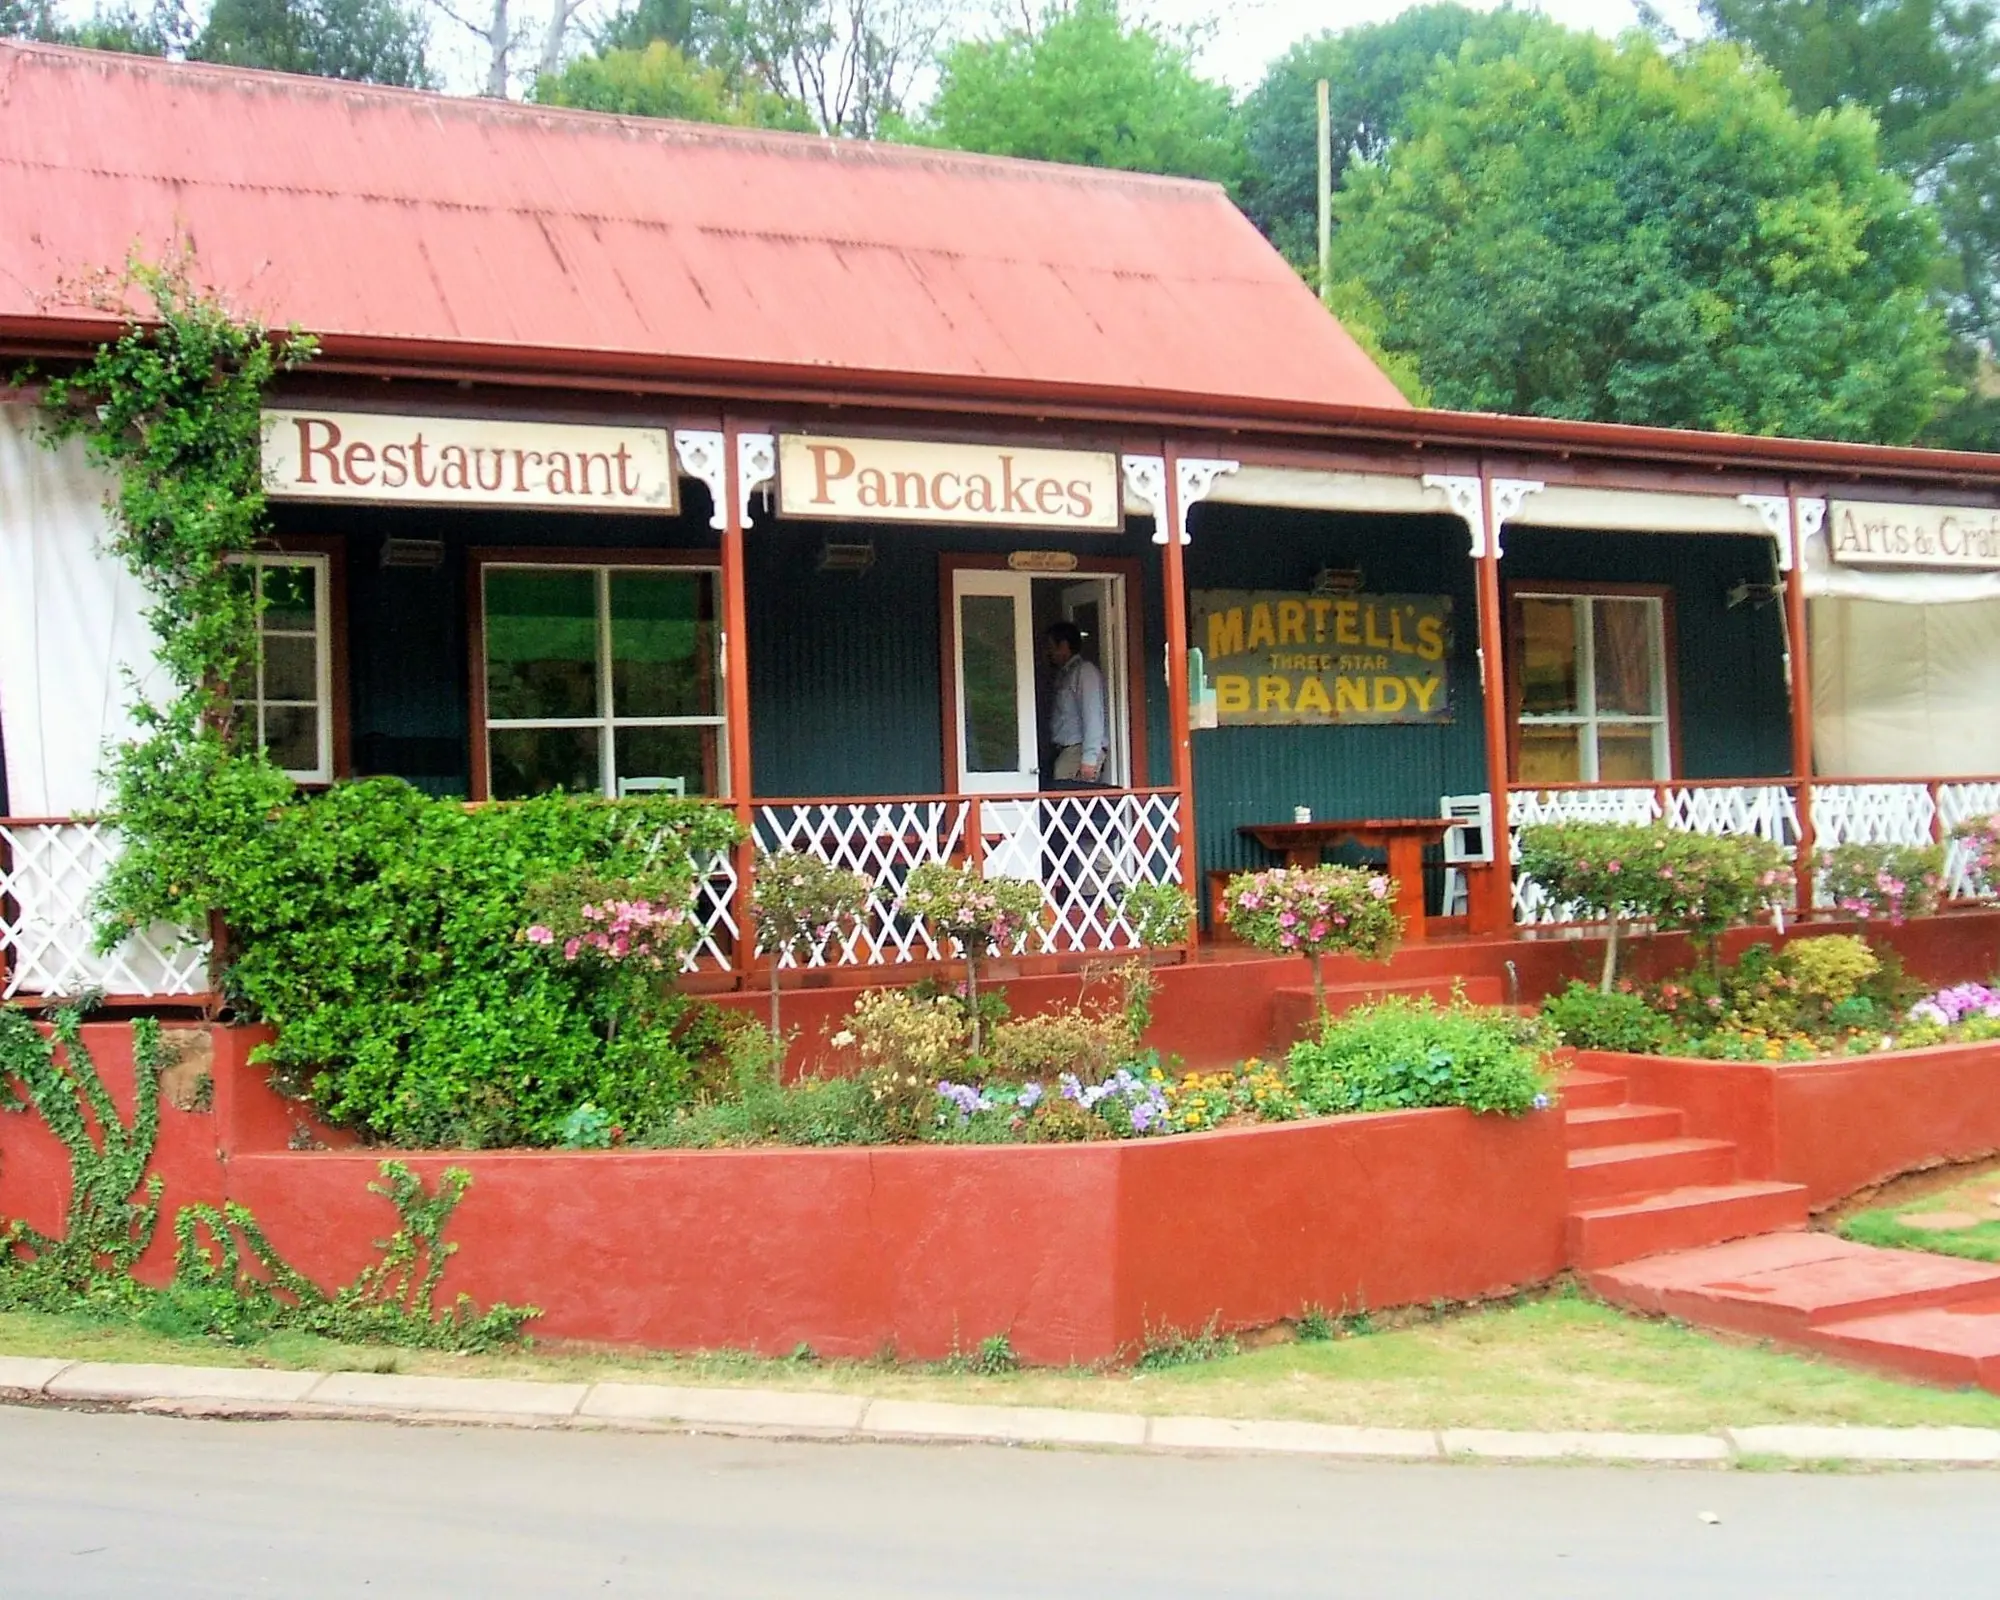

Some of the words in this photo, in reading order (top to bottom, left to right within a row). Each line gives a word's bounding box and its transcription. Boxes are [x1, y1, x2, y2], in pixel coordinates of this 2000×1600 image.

[292, 417, 640, 496] Restaurant
[806, 444, 1093, 518] Pancakes
[1207, 598, 1443, 661] MARTELL'S
[1216, 675, 1440, 712] BRANDY
[1269, 653, 1331, 671] THREE
[1340, 654, 1388, 671] STAR
